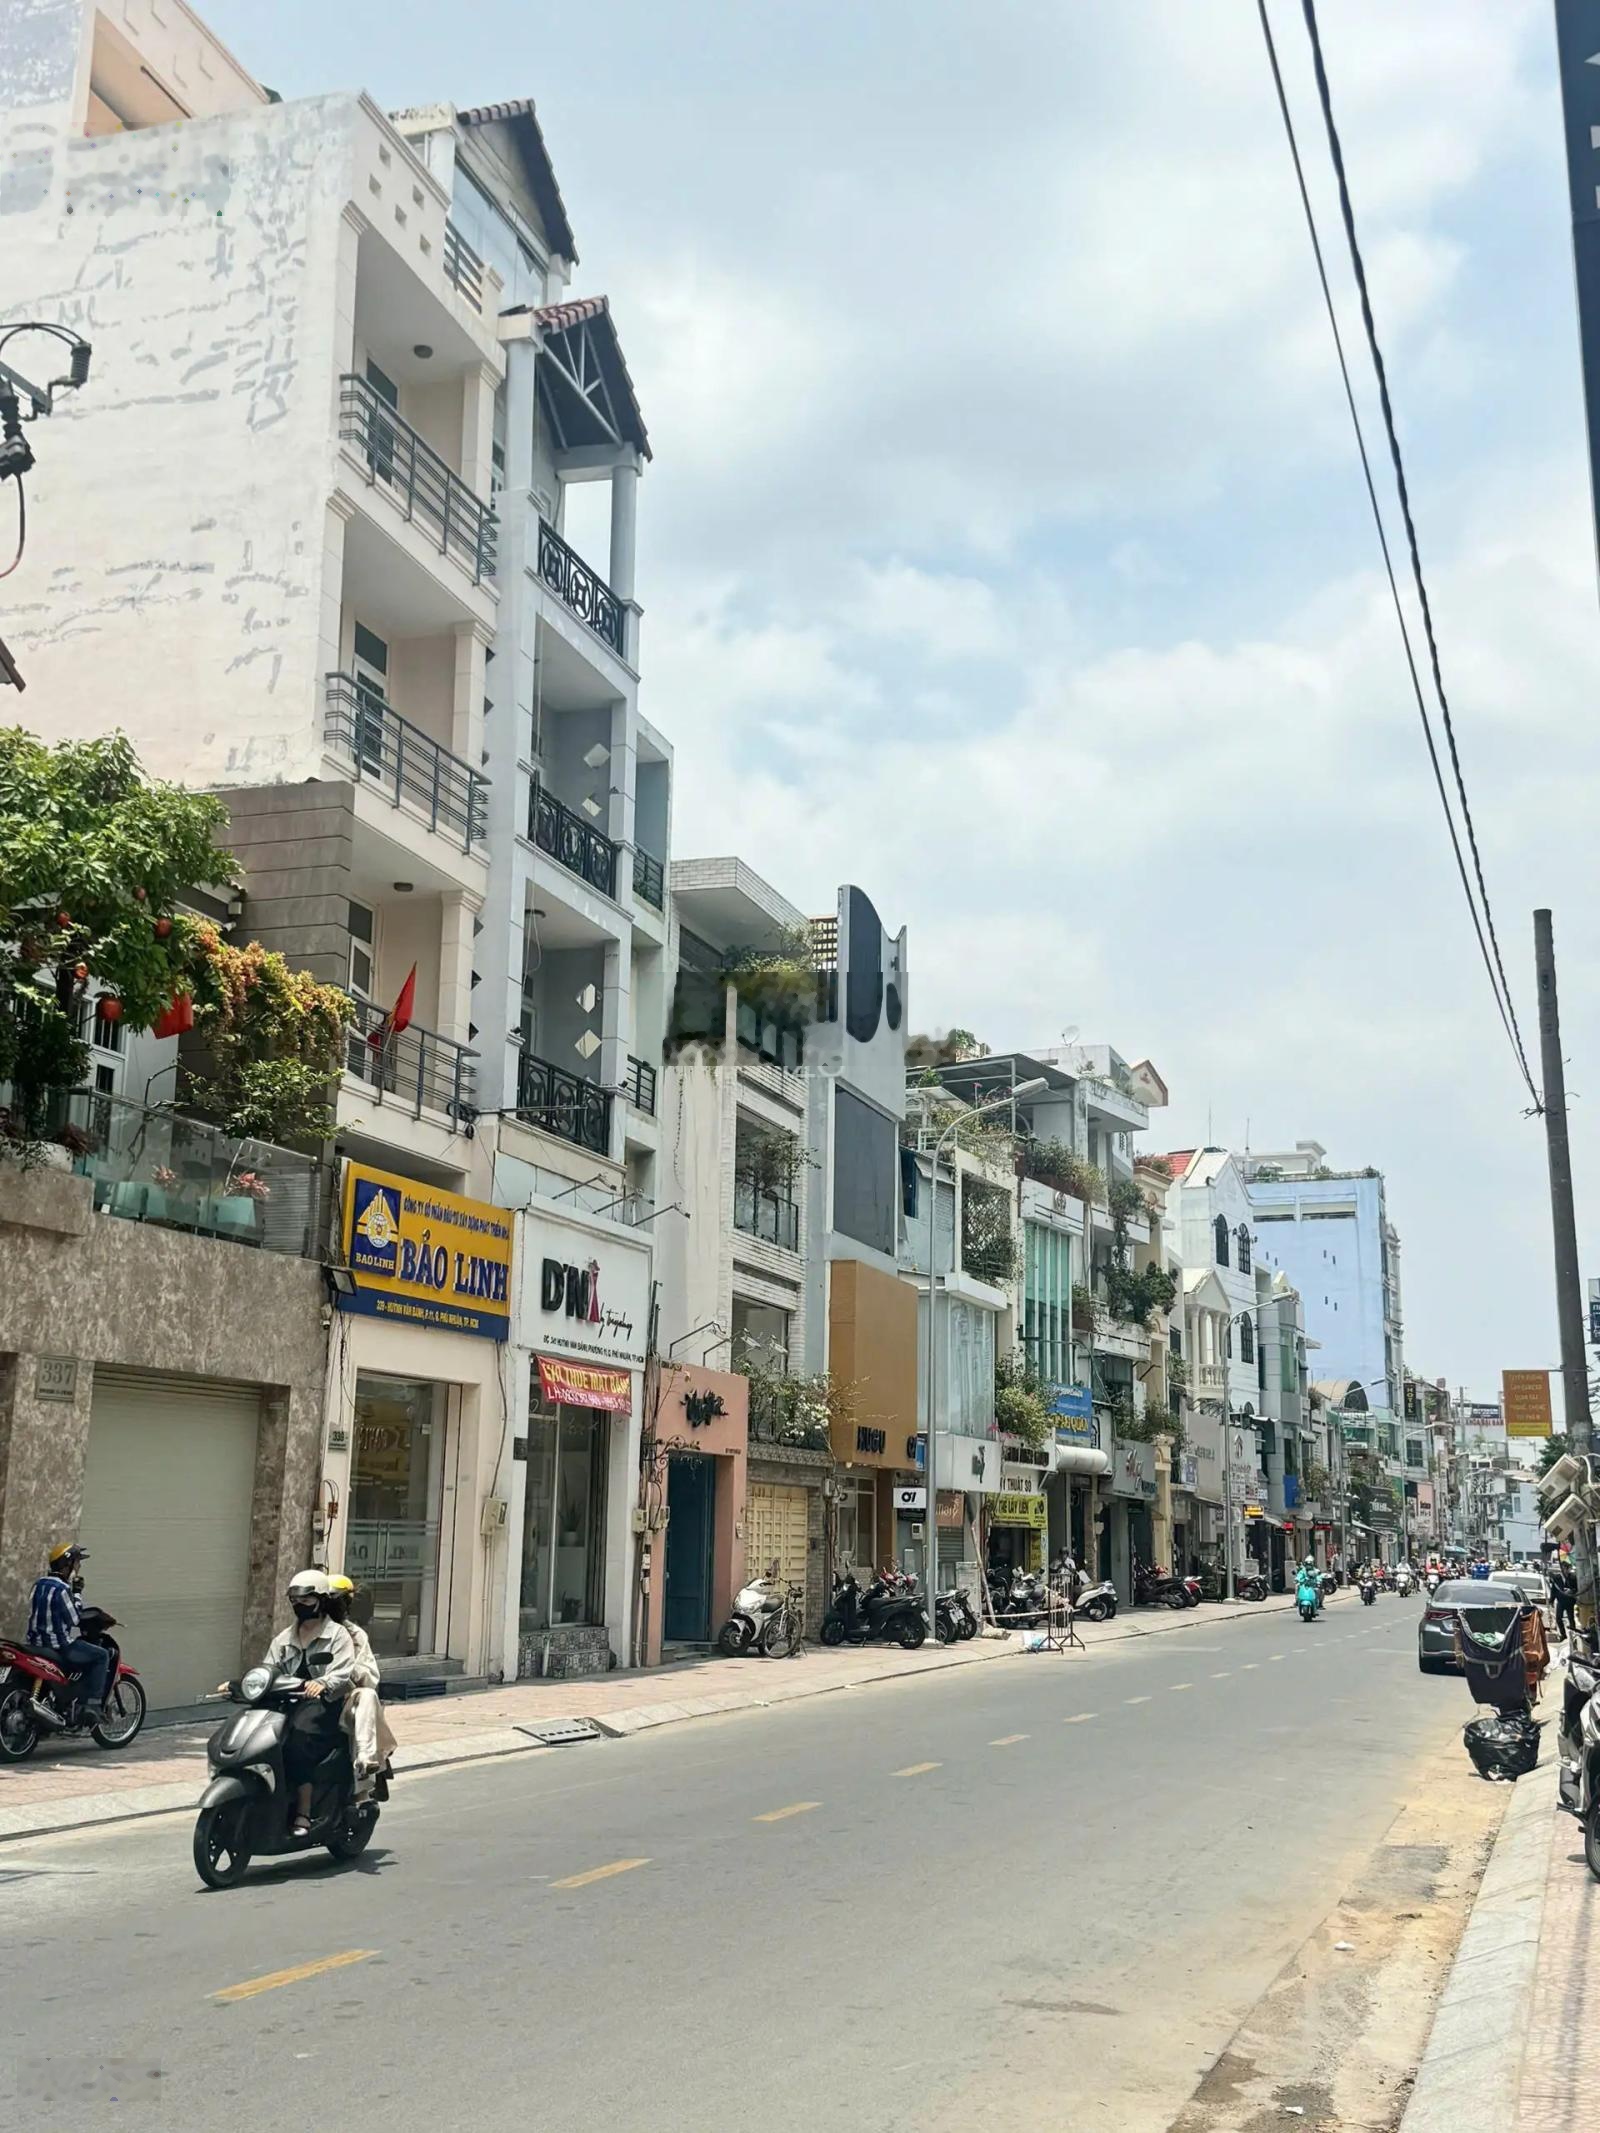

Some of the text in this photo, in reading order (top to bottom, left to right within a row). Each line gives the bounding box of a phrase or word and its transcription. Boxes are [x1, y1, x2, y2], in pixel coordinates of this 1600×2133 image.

[355, 1252, 395, 1270] BAO LINH
[399, 1229, 510, 1302] BẢO LINH
[41, 1360, 74, 1386] 337
